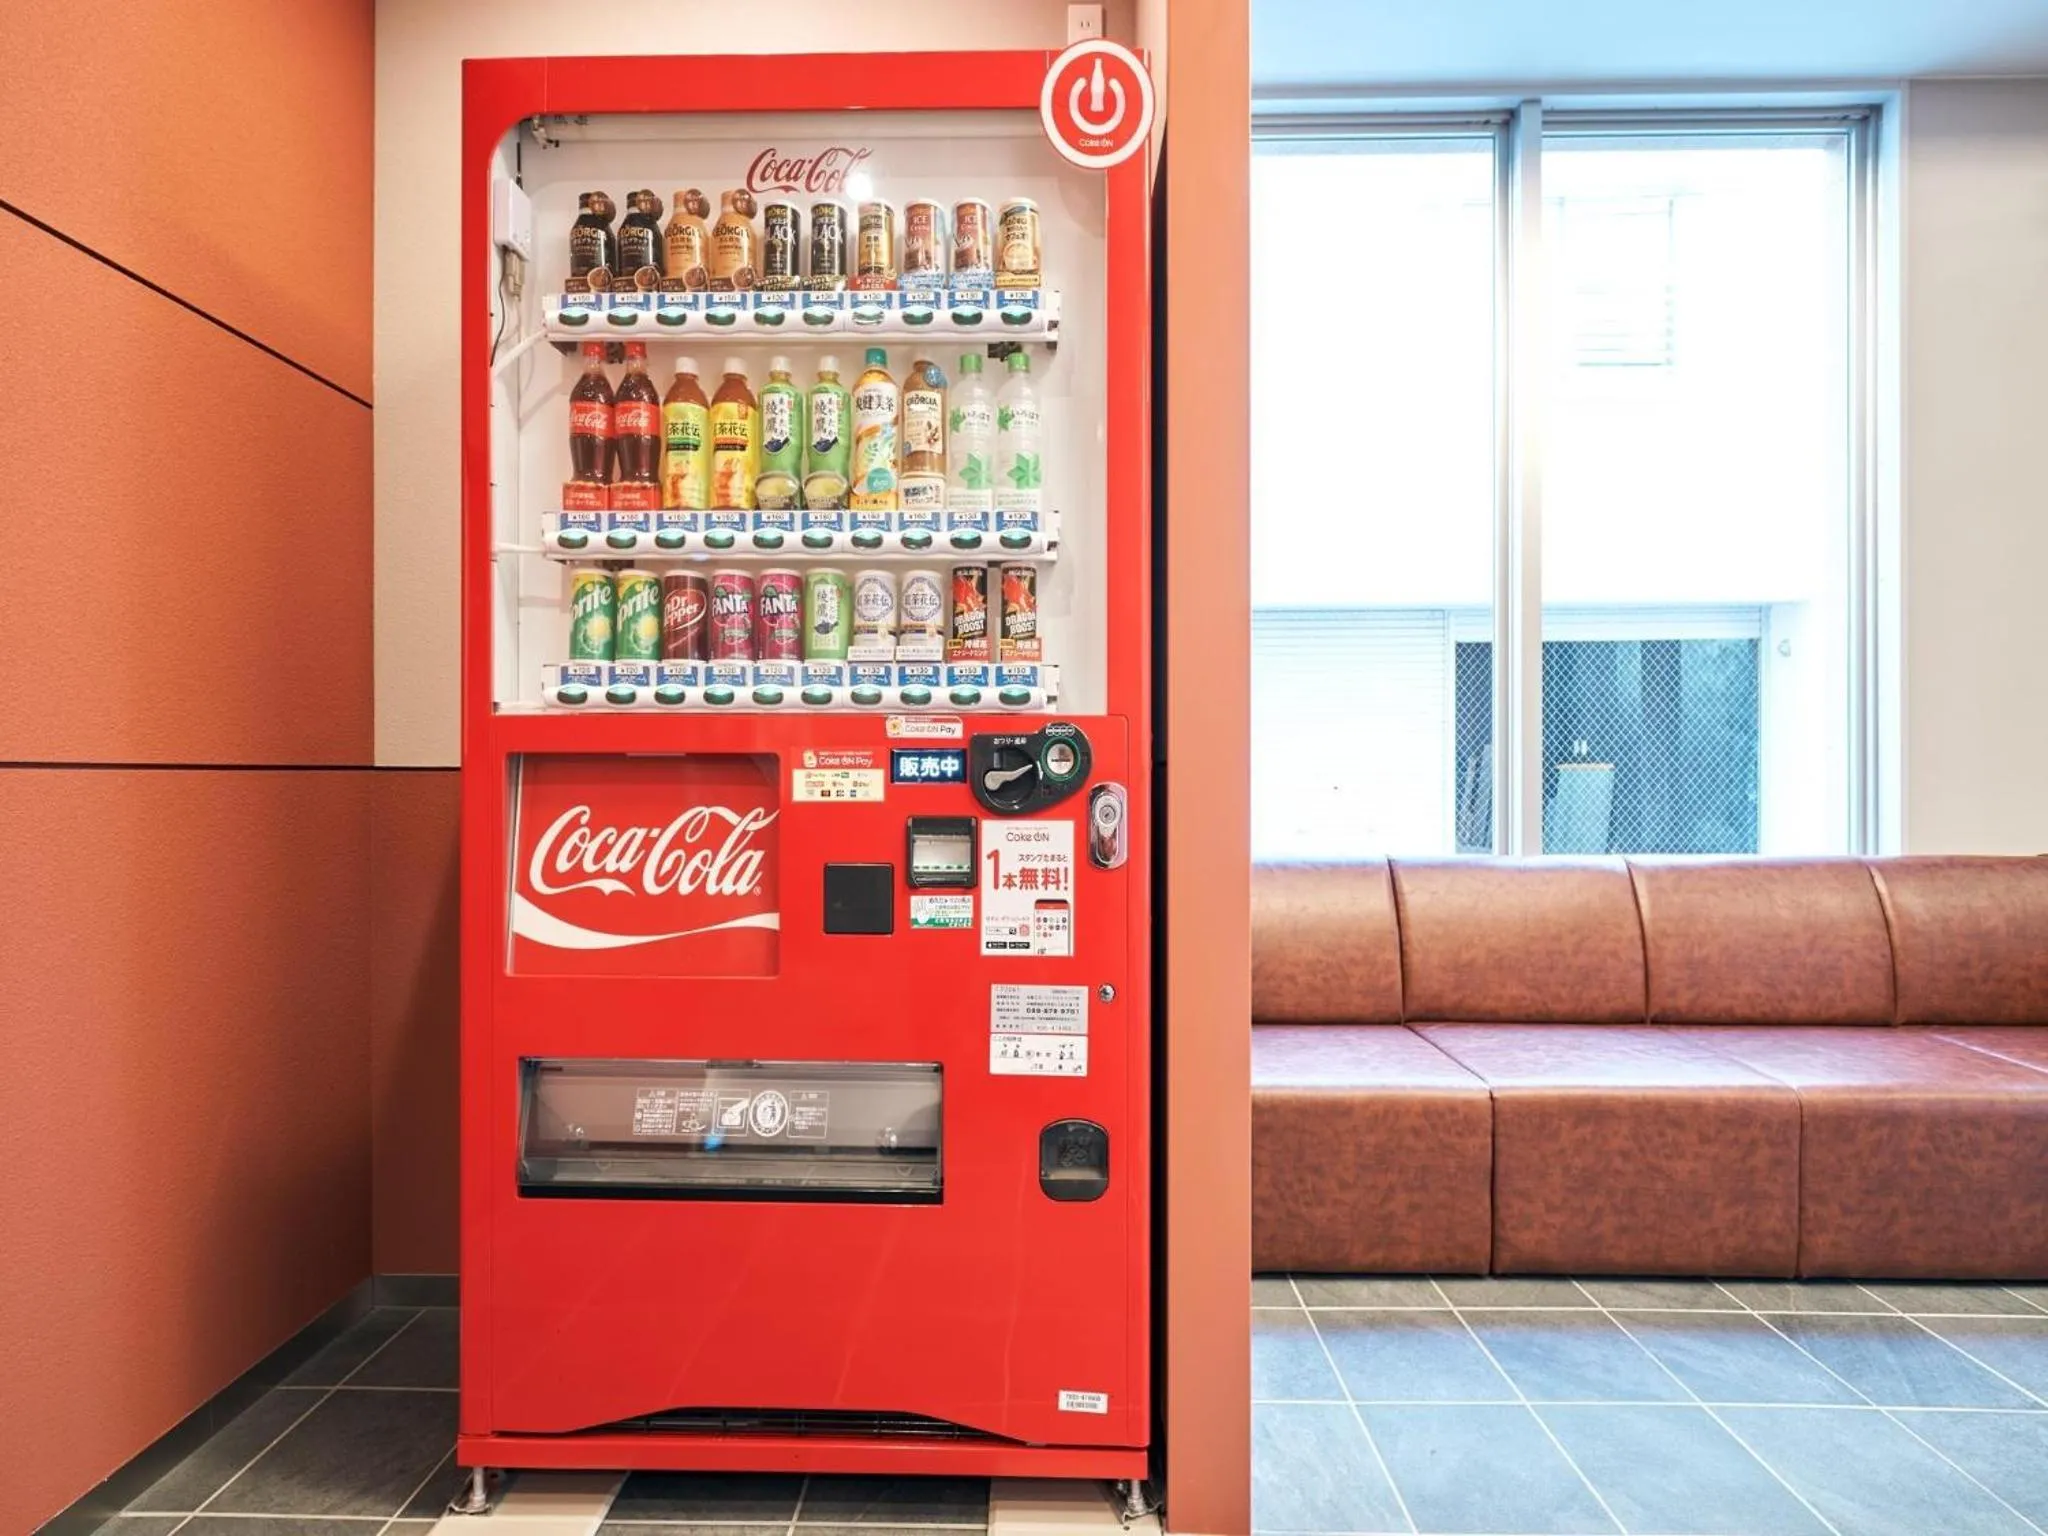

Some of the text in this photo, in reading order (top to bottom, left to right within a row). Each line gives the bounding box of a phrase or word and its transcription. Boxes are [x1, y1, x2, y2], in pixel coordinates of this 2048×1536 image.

[747, 147, 872, 194] Coca-Col
[671, 595, 688, 611] Dr
[760, 593, 799, 617] FANTA
[940, 725, 956, 735] Pay
[899, 756, 959, 777] 販売中
[1006, 832, 1032, 842] Coke
[529, 804, 780, 896] Coca-Cola
[1018, 854, 1069, 862] スタンプたまると
[986, 849, 1069, 890] 1本無料!
